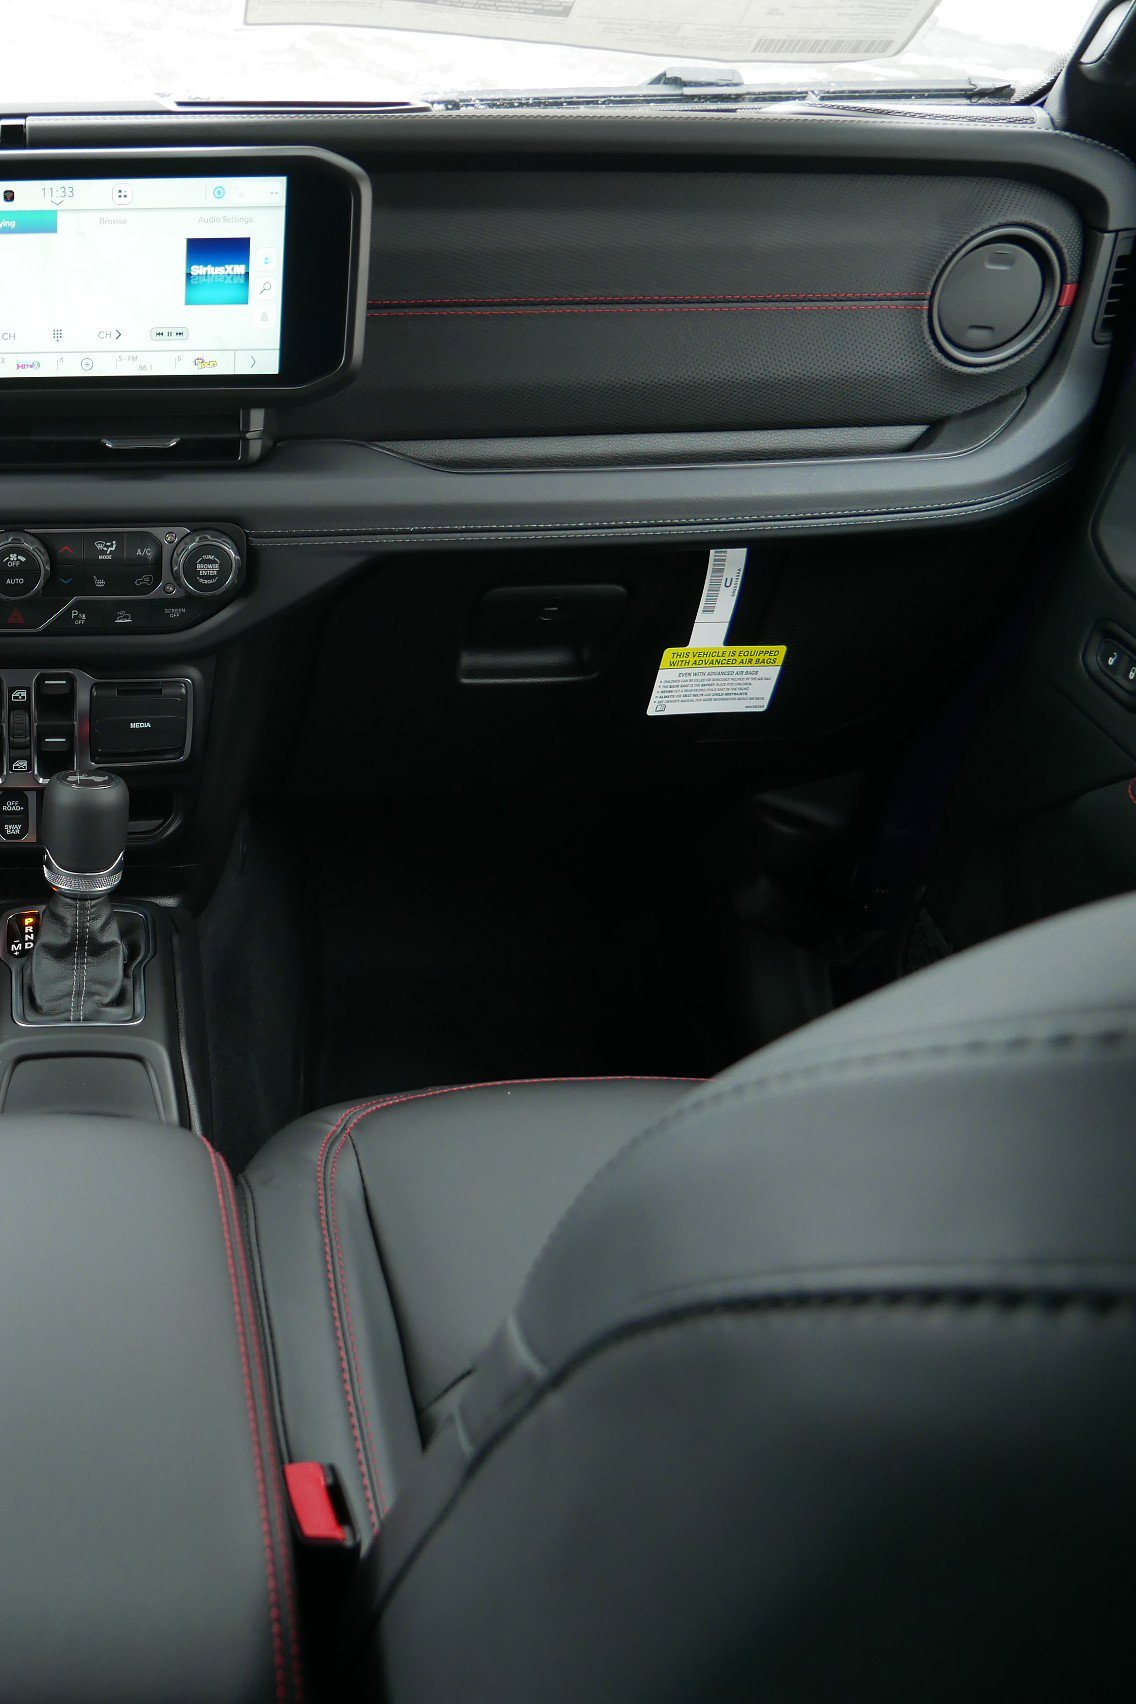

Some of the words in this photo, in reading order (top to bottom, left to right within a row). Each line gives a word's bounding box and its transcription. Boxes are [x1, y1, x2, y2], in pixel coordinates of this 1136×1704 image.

[40, 186, 74, 199] 11:33
[99, 217, 128, 225] Browse
[198, 216, 221, 224] Audio
[222, 215, 253, 225] Settings
[190, 264, 246, 276] SiriusXM
[2, 332, 16, 341] CH
[98, 331, 112, 339] CH
[136, 548, 151, 556] A/C
[5, 577, 25, 585] AUTO
[671, 651, 690, 659] THIS
[738, 649, 780, 657] EQUIPPED
[692, 658, 737, 666] ADVANCED
[755, 657, 777, 665] BAGS
[130, 721, 151, 729] MEDIA
[24, 917, 34, 926] P
[11, 943, 22, 951] M
